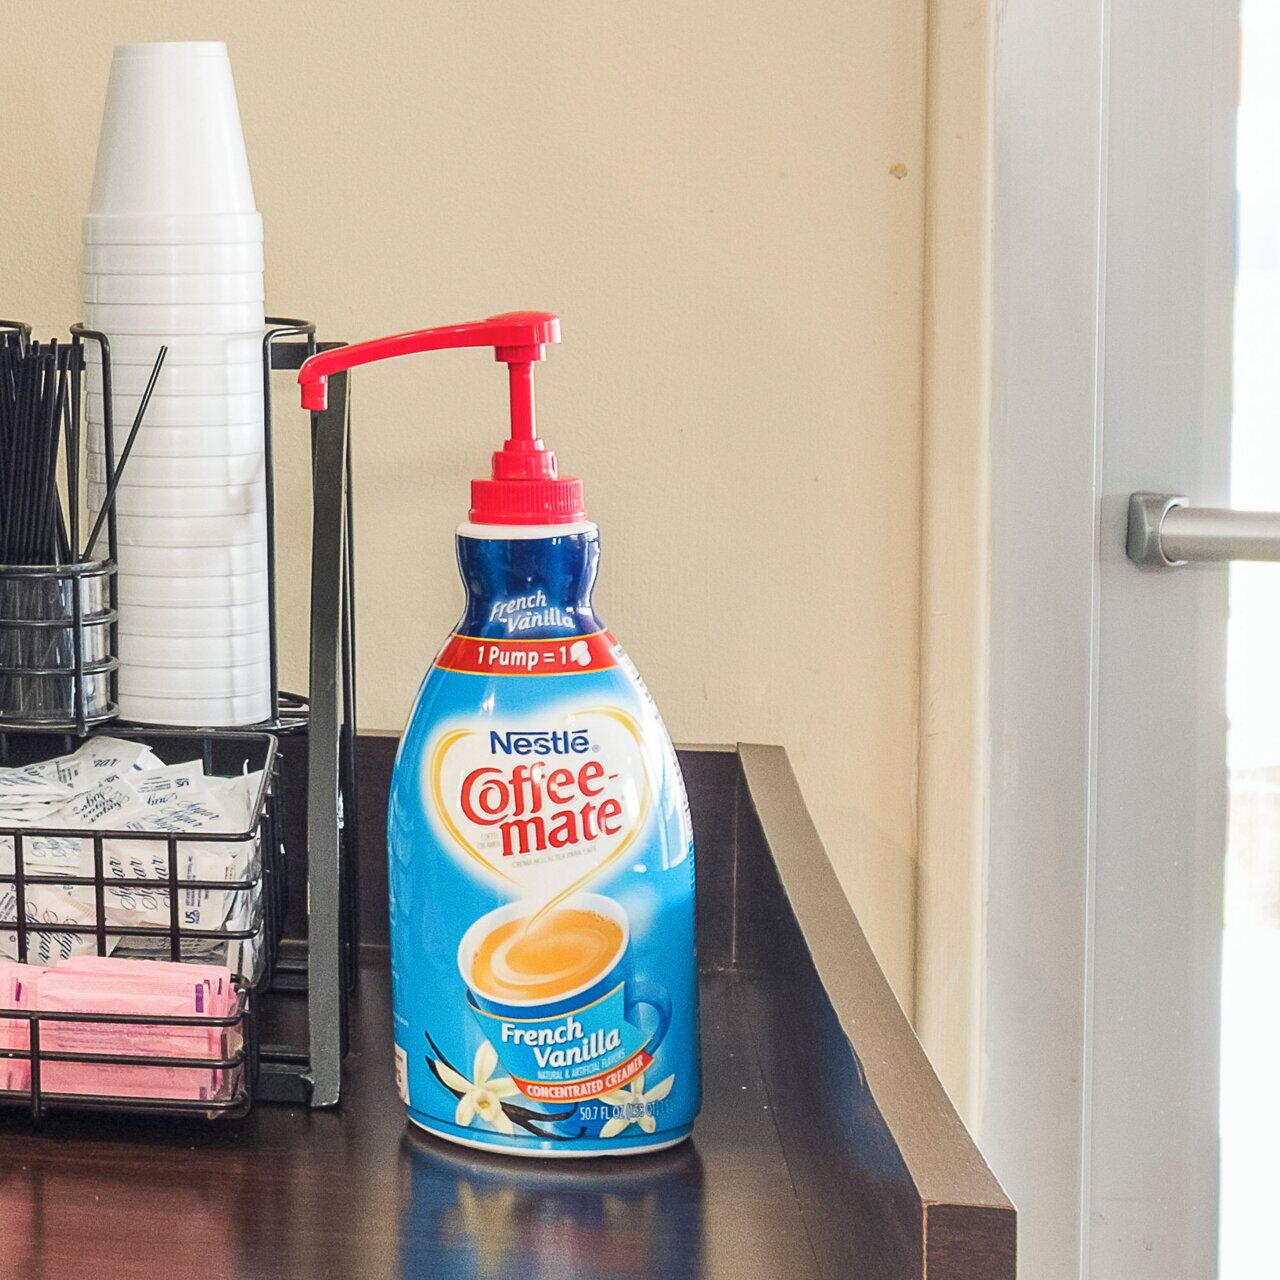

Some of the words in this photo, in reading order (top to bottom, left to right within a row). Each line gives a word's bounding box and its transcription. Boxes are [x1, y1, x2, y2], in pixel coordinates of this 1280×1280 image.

[489, 589, 547, 622] French
[478, 646, 485, 664] 1
[489, 646, 539, 671] Pump
[560, 646, 566, 664] 1
[490, 728, 591, 756] Nestlé
[499, 798, 624, 857] mate
[501, 1016, 585, 1046] French
[532, 1028, 622, 1069] Vanilla
[526, 1078, 603, 1099] CONCENTRATED
[605, 1054, 645, 1089] CREAMER
[537, 1069, 564, 1081] NATURAL
[565, 1070, 571, 1079] &
[580, 1106, 598, 1121] 50.7
[600, 1106, 611, 1120] FL
[612, 1104, 625, 1119] OZ
